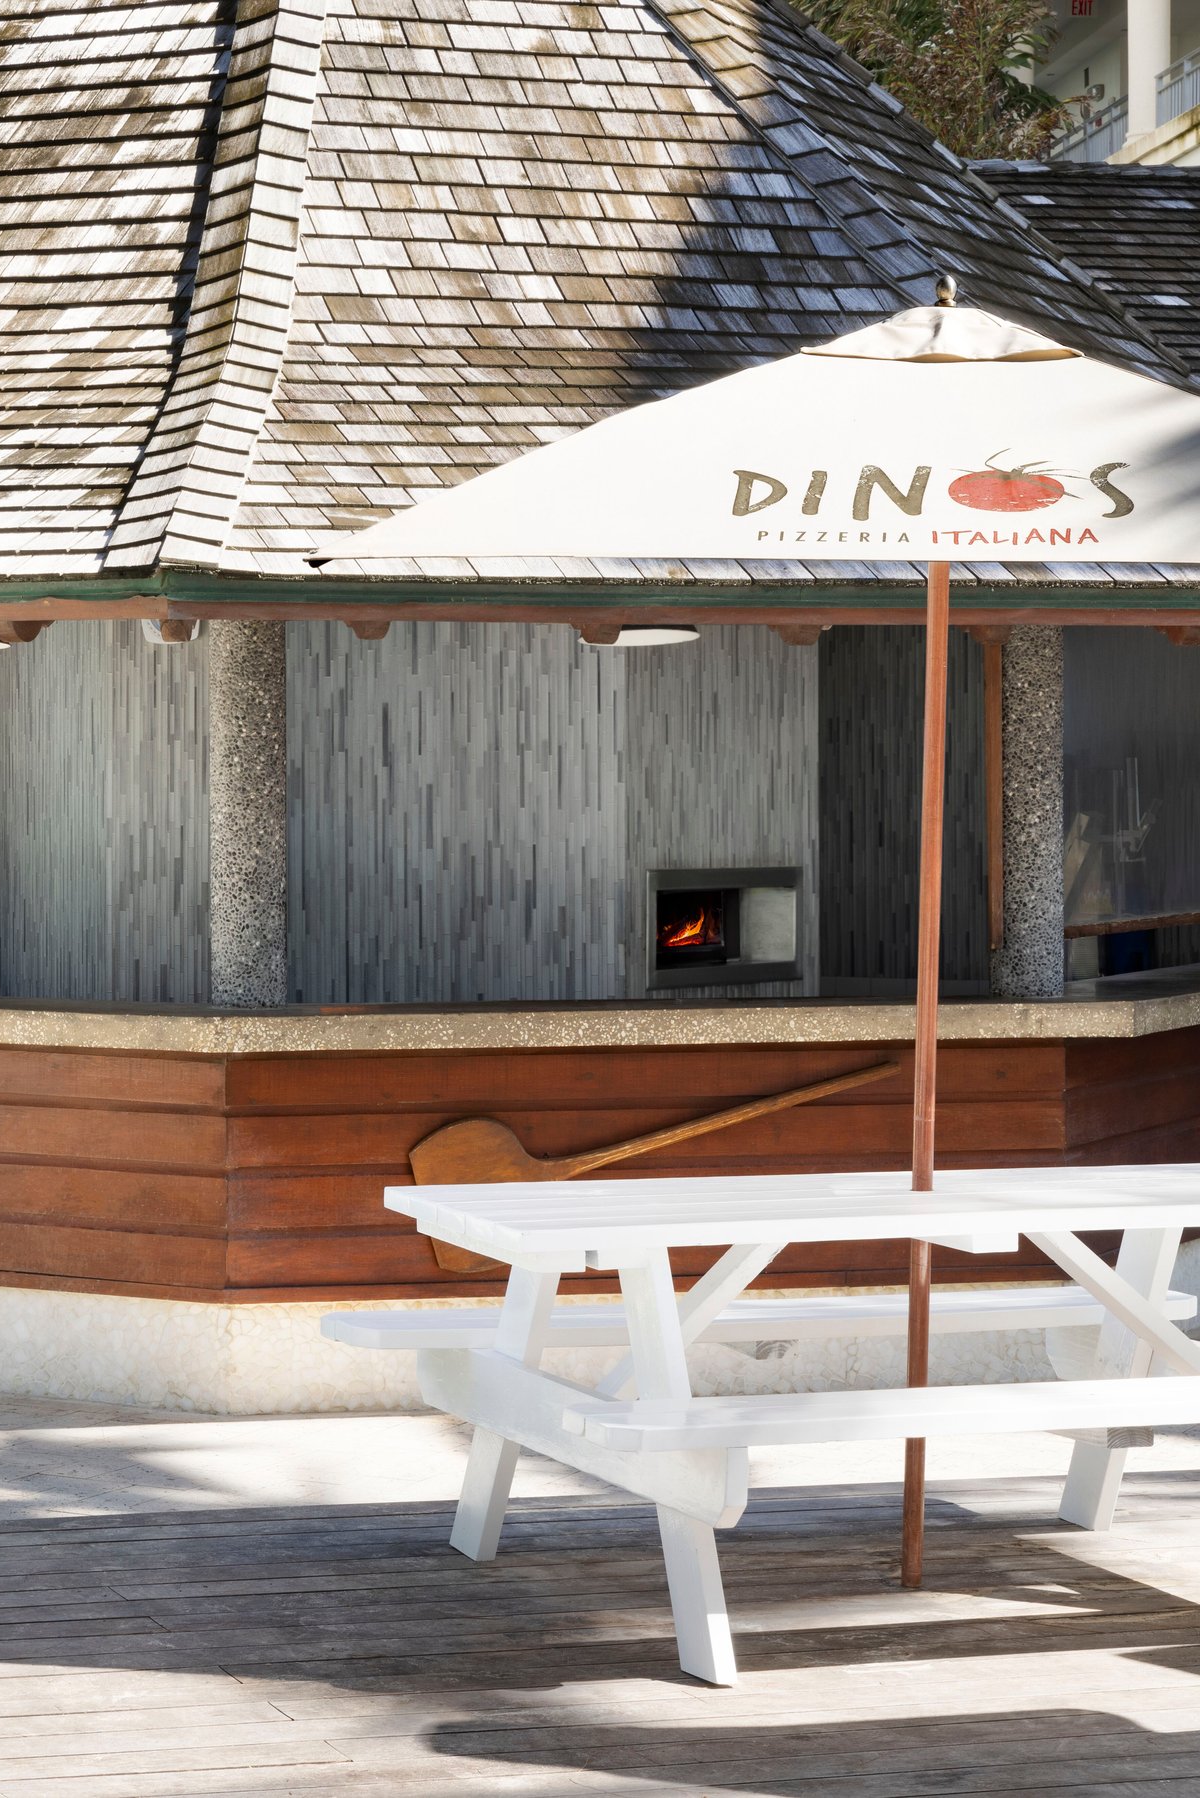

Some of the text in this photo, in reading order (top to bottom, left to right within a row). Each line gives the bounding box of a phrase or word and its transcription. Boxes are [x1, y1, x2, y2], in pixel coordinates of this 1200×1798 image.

[1071, 0, 1093, 16] EXIT
[757, 528, 1099, 546] PIZZERIA ITALIANA
